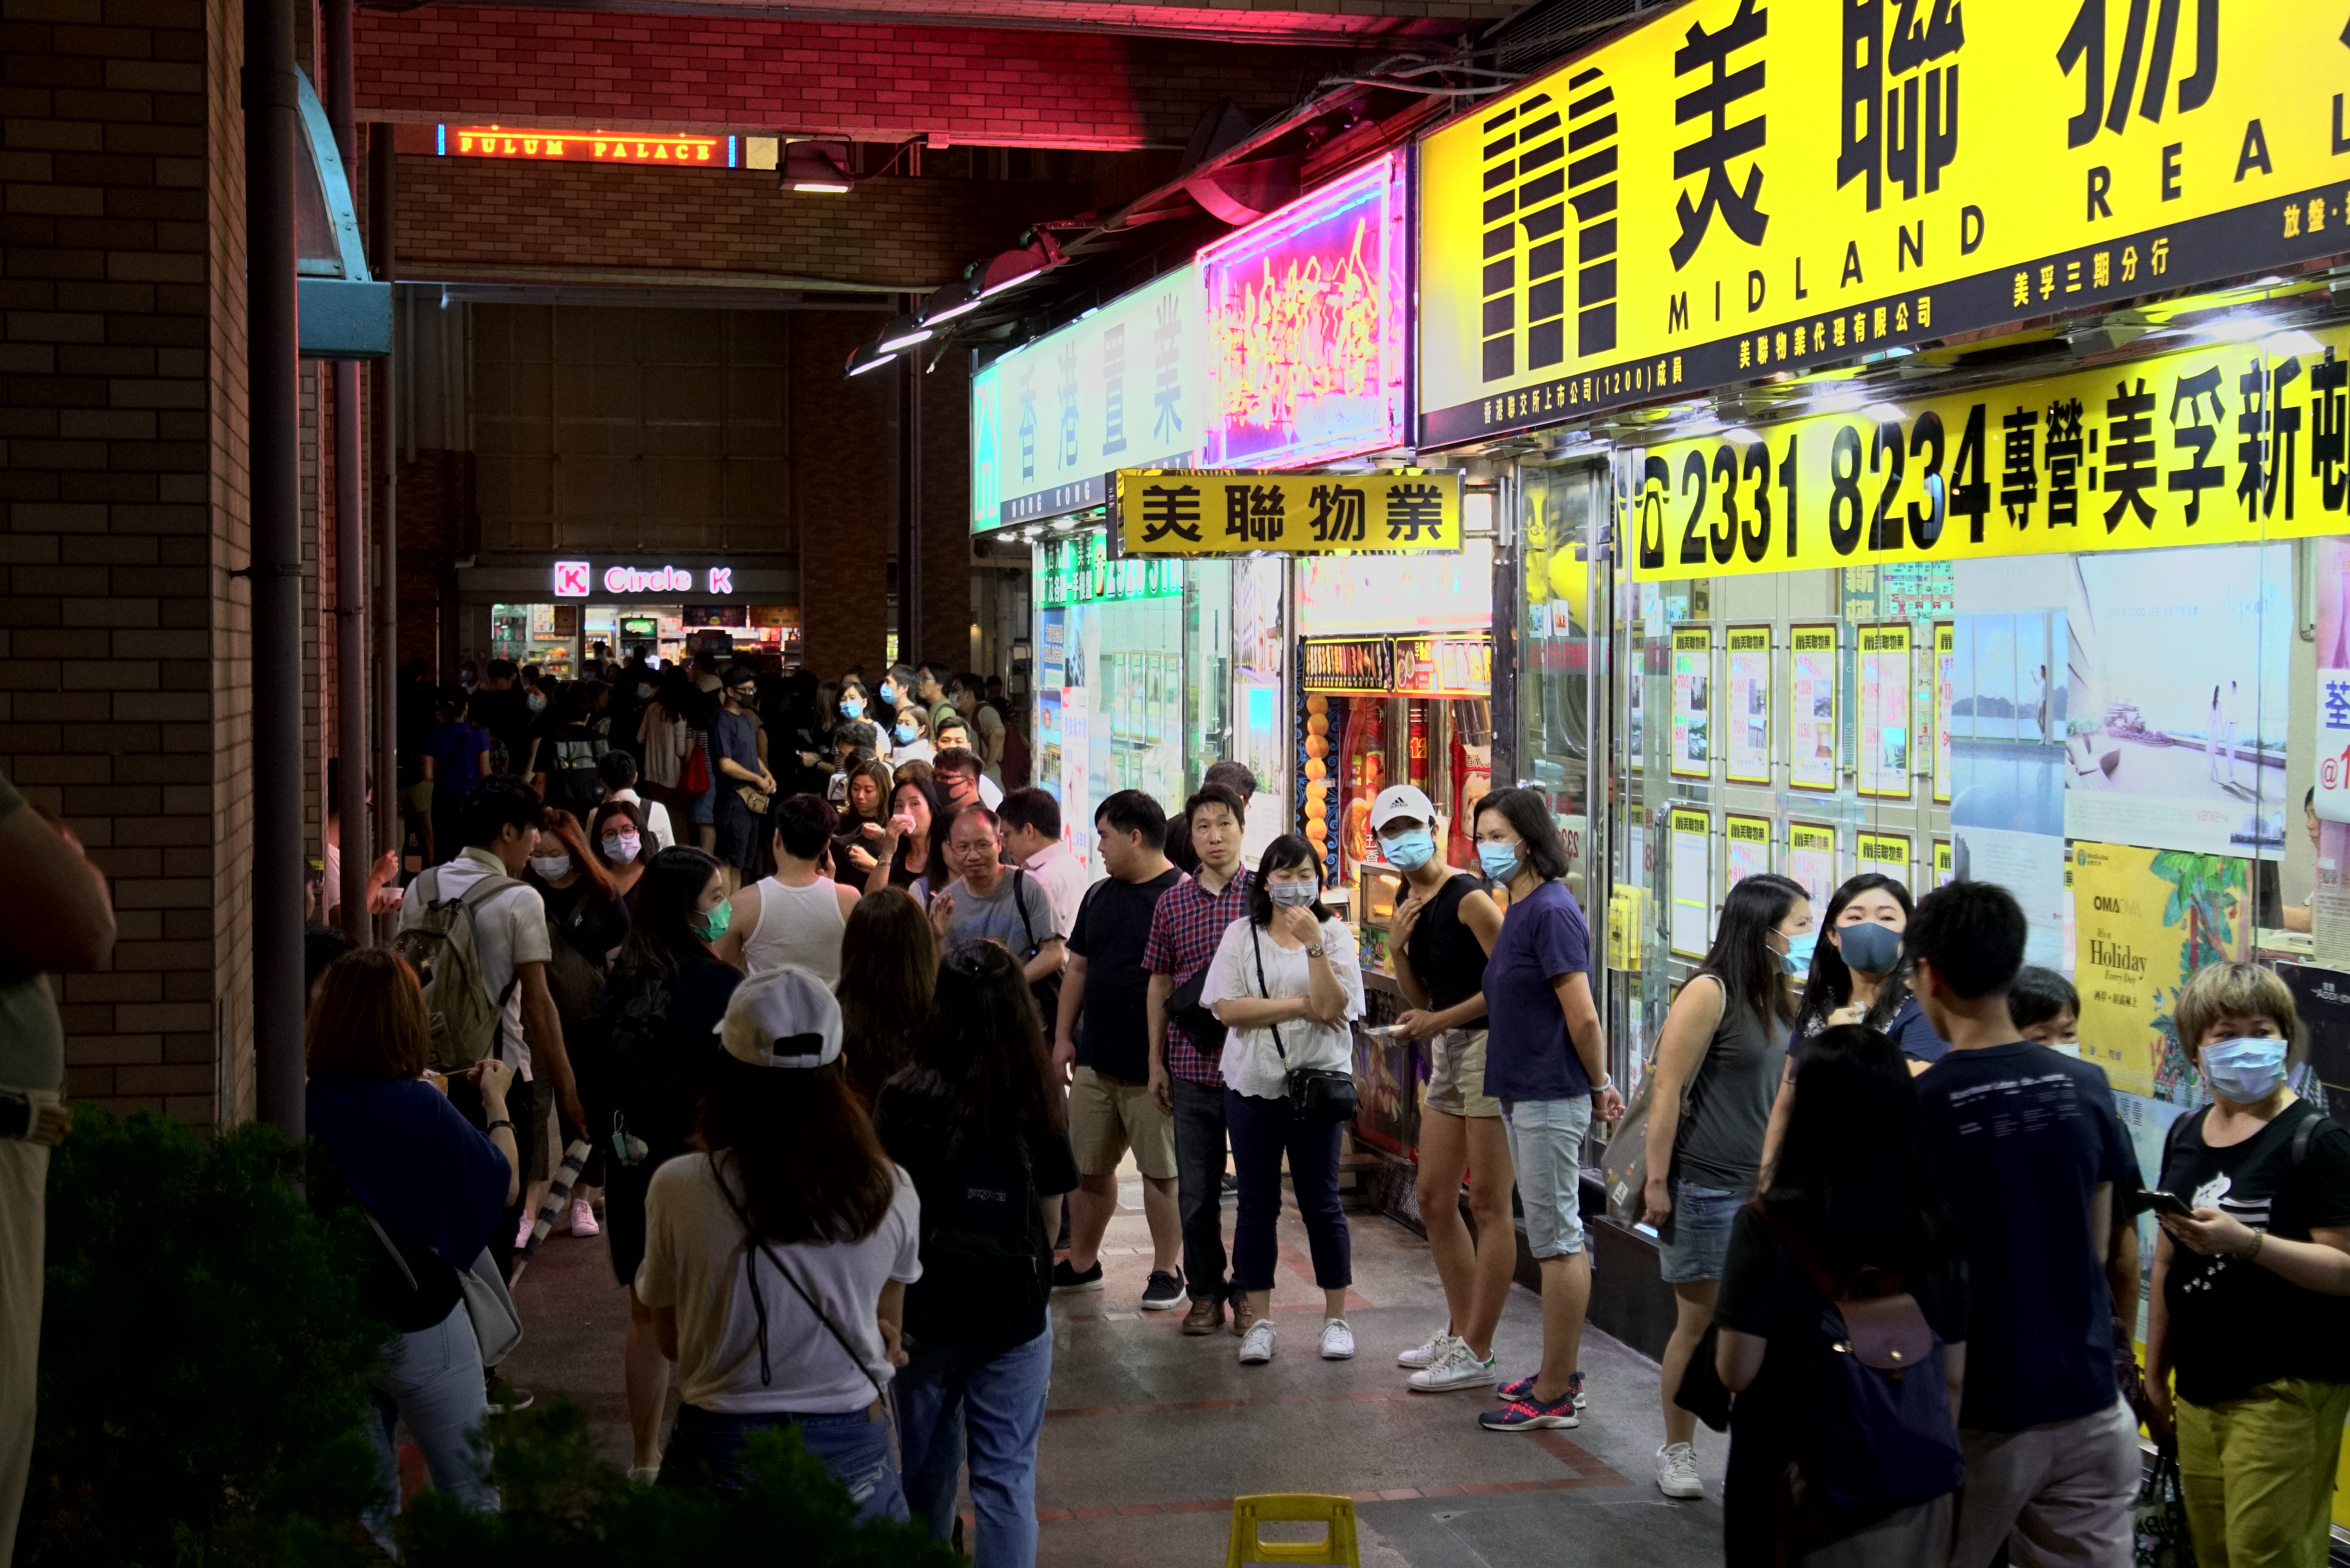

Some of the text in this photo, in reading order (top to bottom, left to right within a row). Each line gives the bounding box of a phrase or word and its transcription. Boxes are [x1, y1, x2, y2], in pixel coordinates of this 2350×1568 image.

[461, 137, 710, 161] FULUM PALACE
[1668, 205, 1985, 335] MIDLAND
[2013, 238, 2169, 307] 美孚三期分行
[1739, 296, 1932, 369] 美聯物業代理有限公司
[1017, 292, 1182, 486] 香港置業
[1484, 356, 1682, 425] 香港聯交所上市公司(1200)成員
[1680, 434, 1798, 565] 2331
[1829, 403, 1990, 555] 8234
[1012, 481, 1090, 518] HONG KONG
[1141, 484, 1442, 543] 美聯物業
[606, 566, 691, 592] Circle
[711, 568, 732, 592] K
[1684, 636, 1706, 650] 美聯物業
[1741, 635, 1765, 649] 美聯物業
[1805, 635, 1830, 649] 美聯物業
[1875, 635, 1904, 650] 美聯物業
[1683, 818, 1705, 833] 美聯物業
[1740, 824, 1765, 841] 美聯物業
[1804, 834, 1829, 850] 美聯物業
[1874, 844, 1903, 862] 美聯物業
[2089, 940, 2147, 980] Holiday
